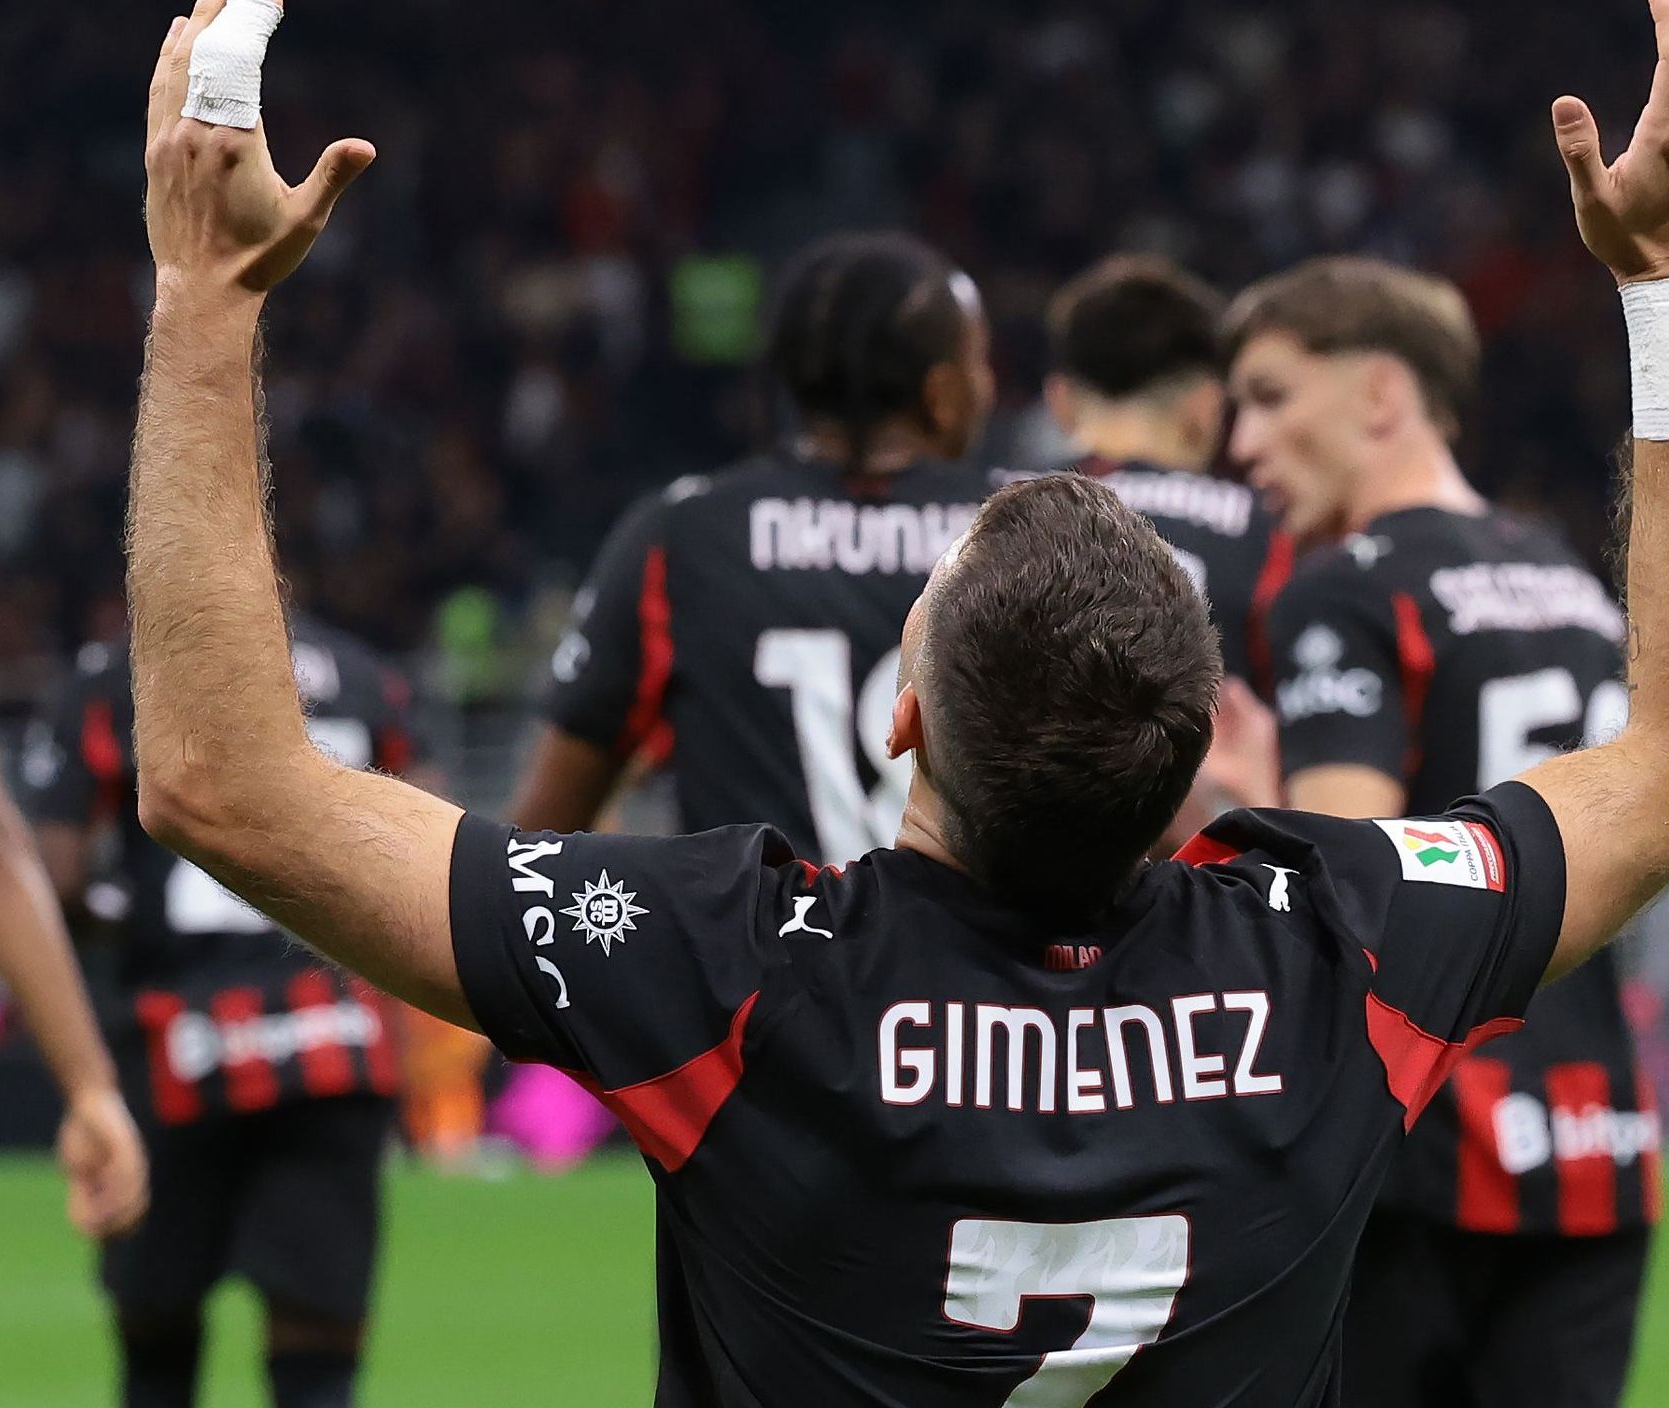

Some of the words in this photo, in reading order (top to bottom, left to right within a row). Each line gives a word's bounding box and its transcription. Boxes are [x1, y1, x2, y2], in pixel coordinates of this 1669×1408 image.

[749, 498, 980, 576] NKUNK
[1464, 849, 1479, 882] COPPA
[877, 990, 1285, 1114] GIMENEZ
